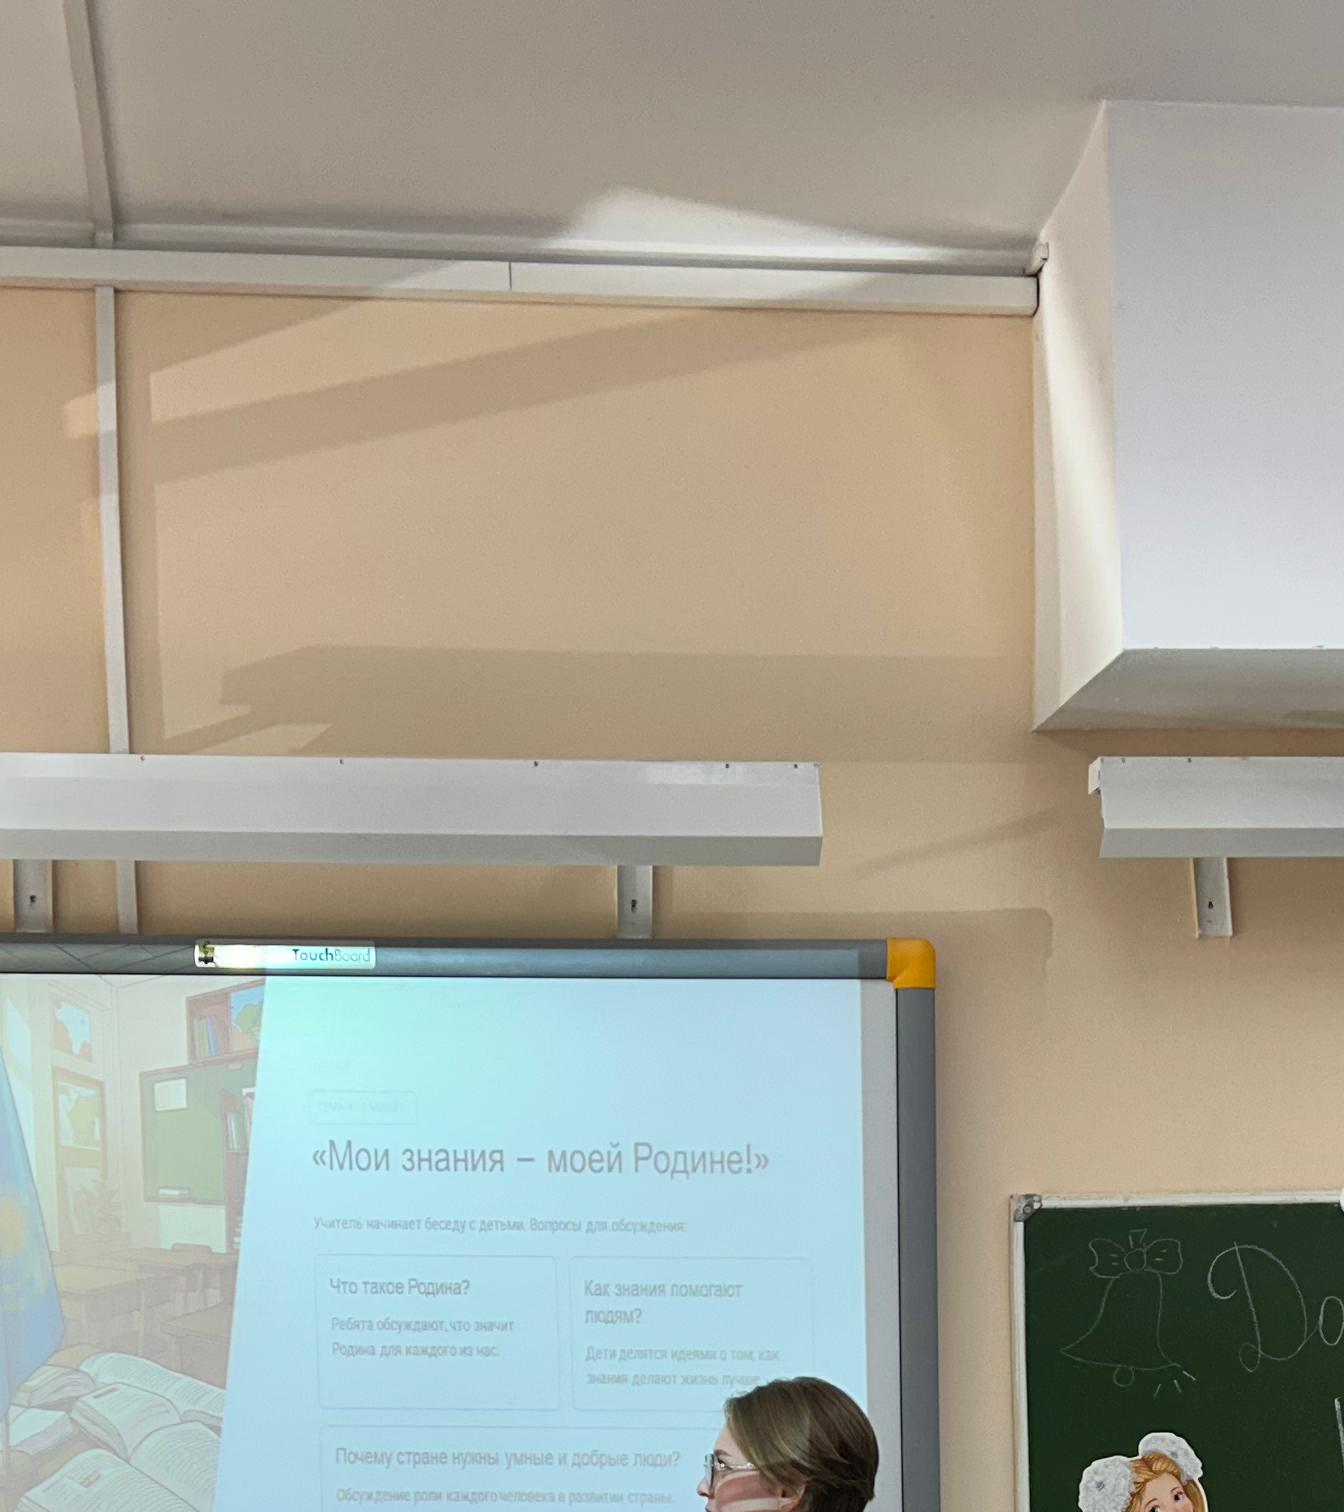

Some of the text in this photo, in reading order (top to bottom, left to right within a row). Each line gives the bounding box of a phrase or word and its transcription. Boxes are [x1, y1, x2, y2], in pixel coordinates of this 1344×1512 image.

[292, 947, 371, 962] TouchBoard
[312, 1139, 390, 1172] «Мои
[400, 1145, 505, 1173] знания
[546, 1142, 623, 1175] моей
[633, 1142, 771, 1180] Родине!»
[313, 1216, 363, 1232] Учитель
[366, 1218, 422, 1232] начинает
[424, 1216, 467, 1235] беседу
[468, 1220, 477, 1231] с
[529, 1218, 583, 1235] Вопросы
[585, 1220, 609, 1234] для
[329, 1278, 471, 1299] Что такое Родина?
[584, 1280, 743, 1299] Как знания помогают
[331, 1317, 374, 1332] Ребята
[449, 1320, 470, 1332] что
[474, 1320, 514, 1332] значит
[584, 1308, 643, 1326] людям?
[332, 1342, 376, 1358] Родина
[380, 1346, 402, 1359] для
[405, 1345, 457, 1359] каждого
[459, 1346, 473, 1357] из
[585, 1346, 616, 1362] Дети
[618, 1348, 668, 1362] делятся
[671, 1348, 717, 1362] идеями
[757, 1349, 781, 1361] как
[586, 1373, 628, 1385] знания
[632, 1373, 677, 1387] делают
[680, 1374, 717, 1386] жизнь
[336, 1447, 681, 1470] Почему стране нужны умные и добрые люди?
[336, 1488, 411, 1505] Обсуждение
[414, 1490, 443, 1506] роли
[446, 1490, 497, 1505] каждого
[499, 1491, 556, 1504] человека
[568, 1492, 624, 1506] развитии
